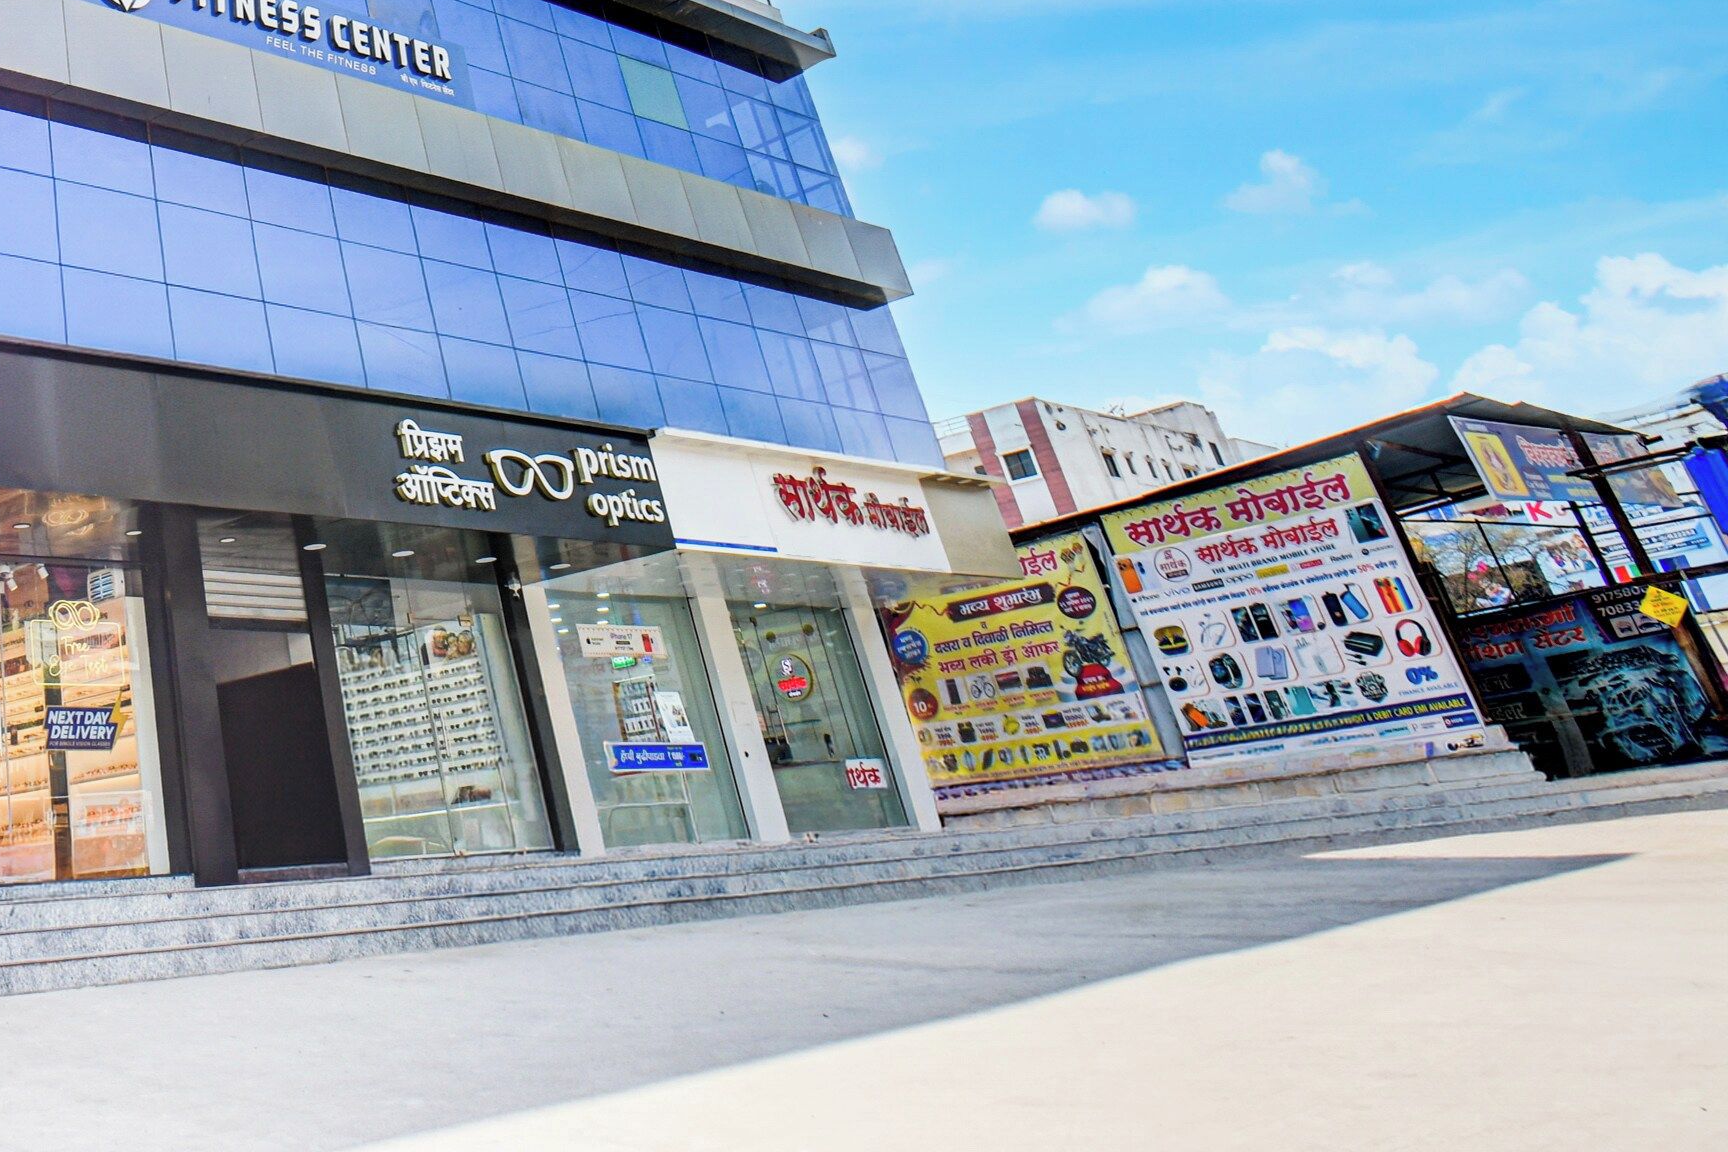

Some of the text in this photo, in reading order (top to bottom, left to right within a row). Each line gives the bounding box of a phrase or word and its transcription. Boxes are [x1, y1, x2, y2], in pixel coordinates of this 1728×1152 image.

[266, 36, 376, 75] FEEL THE FITNESS
[331, 14, 452, 80] CENTER
[398, 419, 465, 463] प्रिझम
[575, 443, 657, 484] prism
[397, 464, 496, 510] ऑप्टिक्स
[772, 466, 930, 538] सार्थक मोबाईल
[588, 489, 664, 526] optics
[1124, 472, 1351, 547] सार्थक मोबाईल
[1195, 515, 1340, 565] सार्थक मोबाईल
[1251, 556, 1278, 567] BRAND
[1279, 550, 1309, 561] MOBILE
[1311, 543, 1336, 555] STORE
[61, 636, 91, 655] Free
[80, 654, 110, 677] Test
[1405, 665, 1439, 685] 0%
[47, 710, 110, 725] NEXT DAY
[50, 723, 115, 740] DELIVERY
